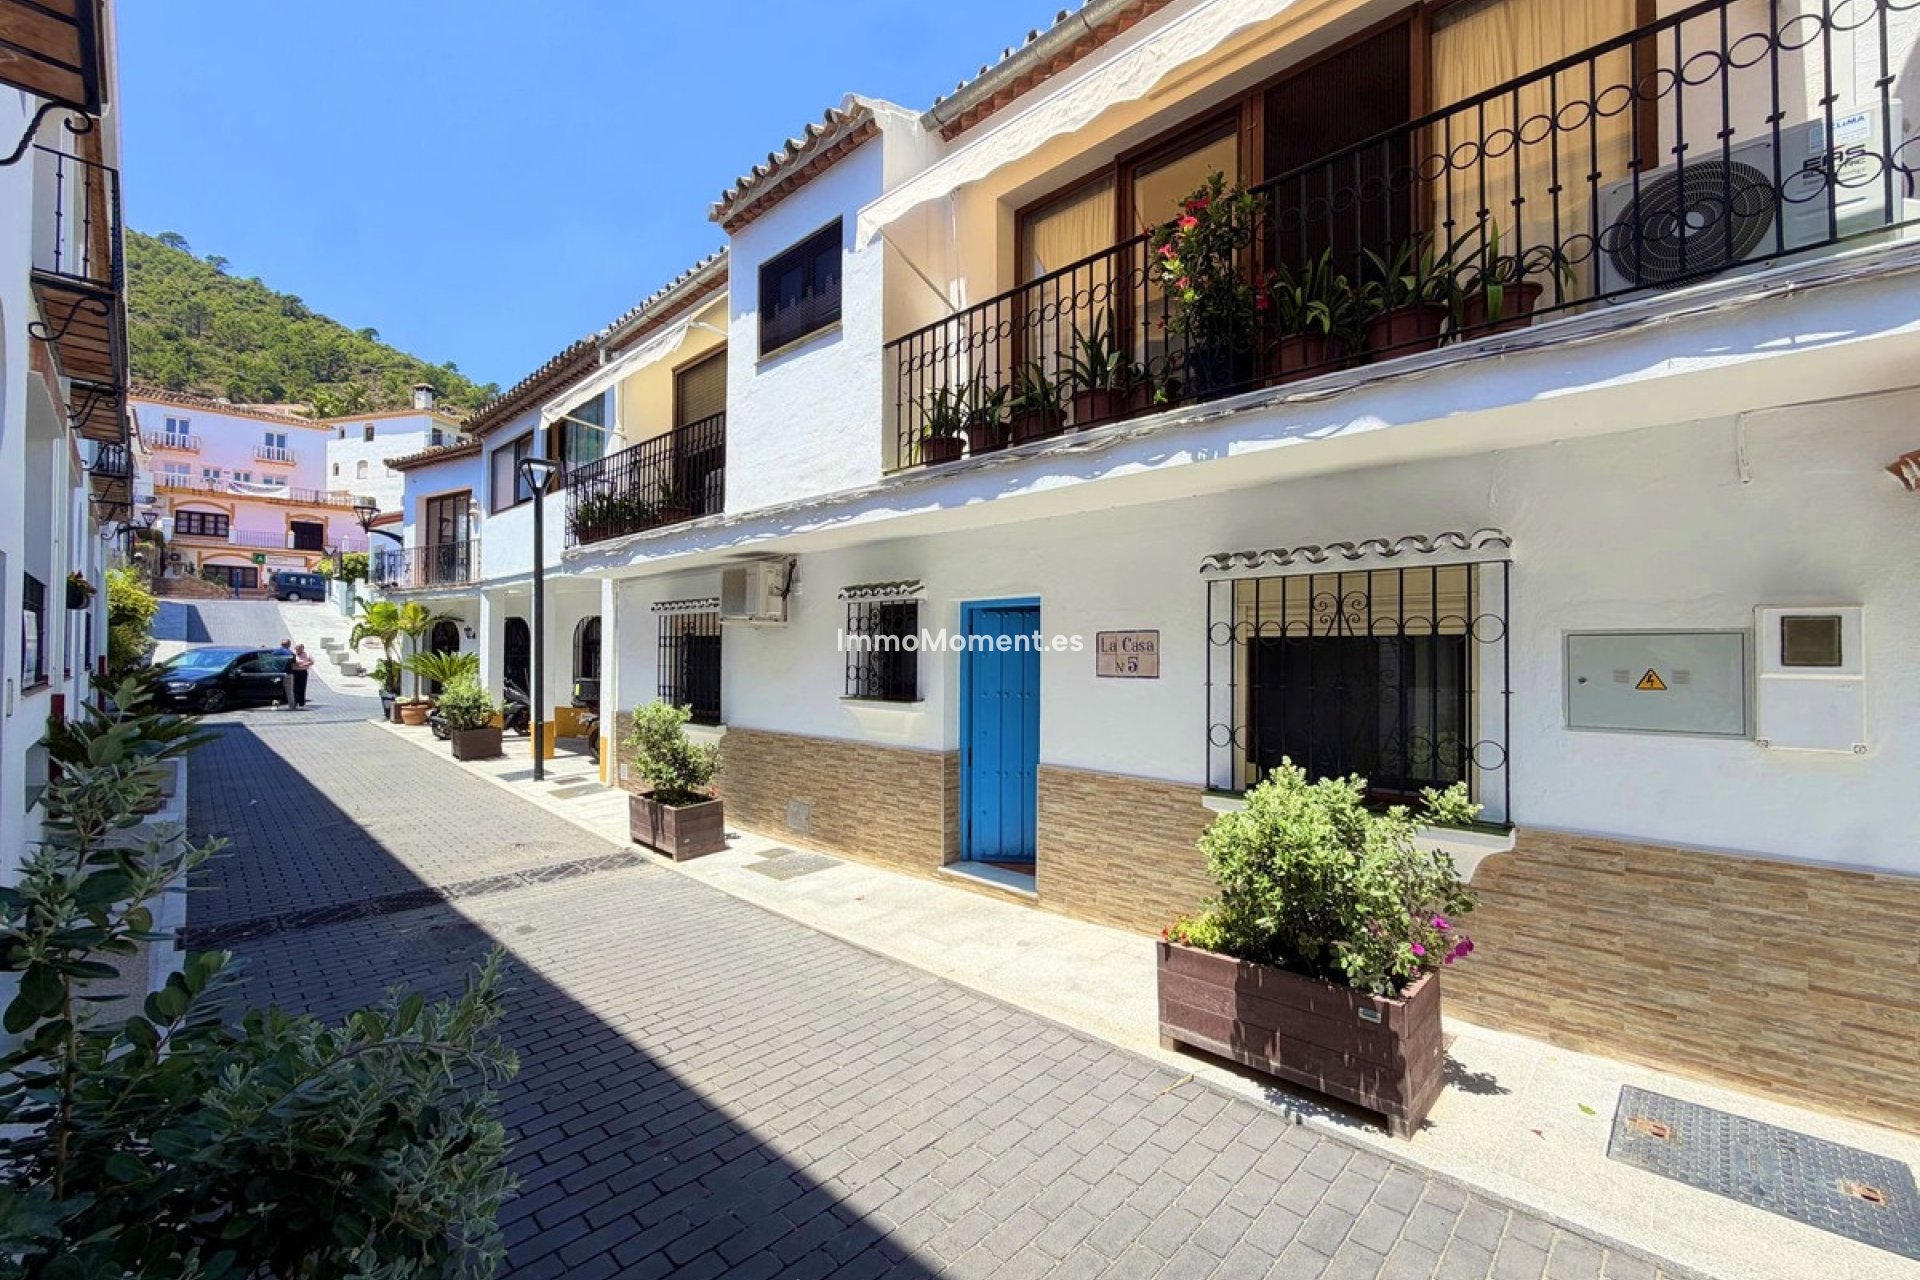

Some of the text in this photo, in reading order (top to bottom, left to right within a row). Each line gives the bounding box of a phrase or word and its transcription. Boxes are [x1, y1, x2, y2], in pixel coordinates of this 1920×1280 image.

[1101, 637, 1155, 653] La Casa
[1127, 656, 1138, 673] 5
